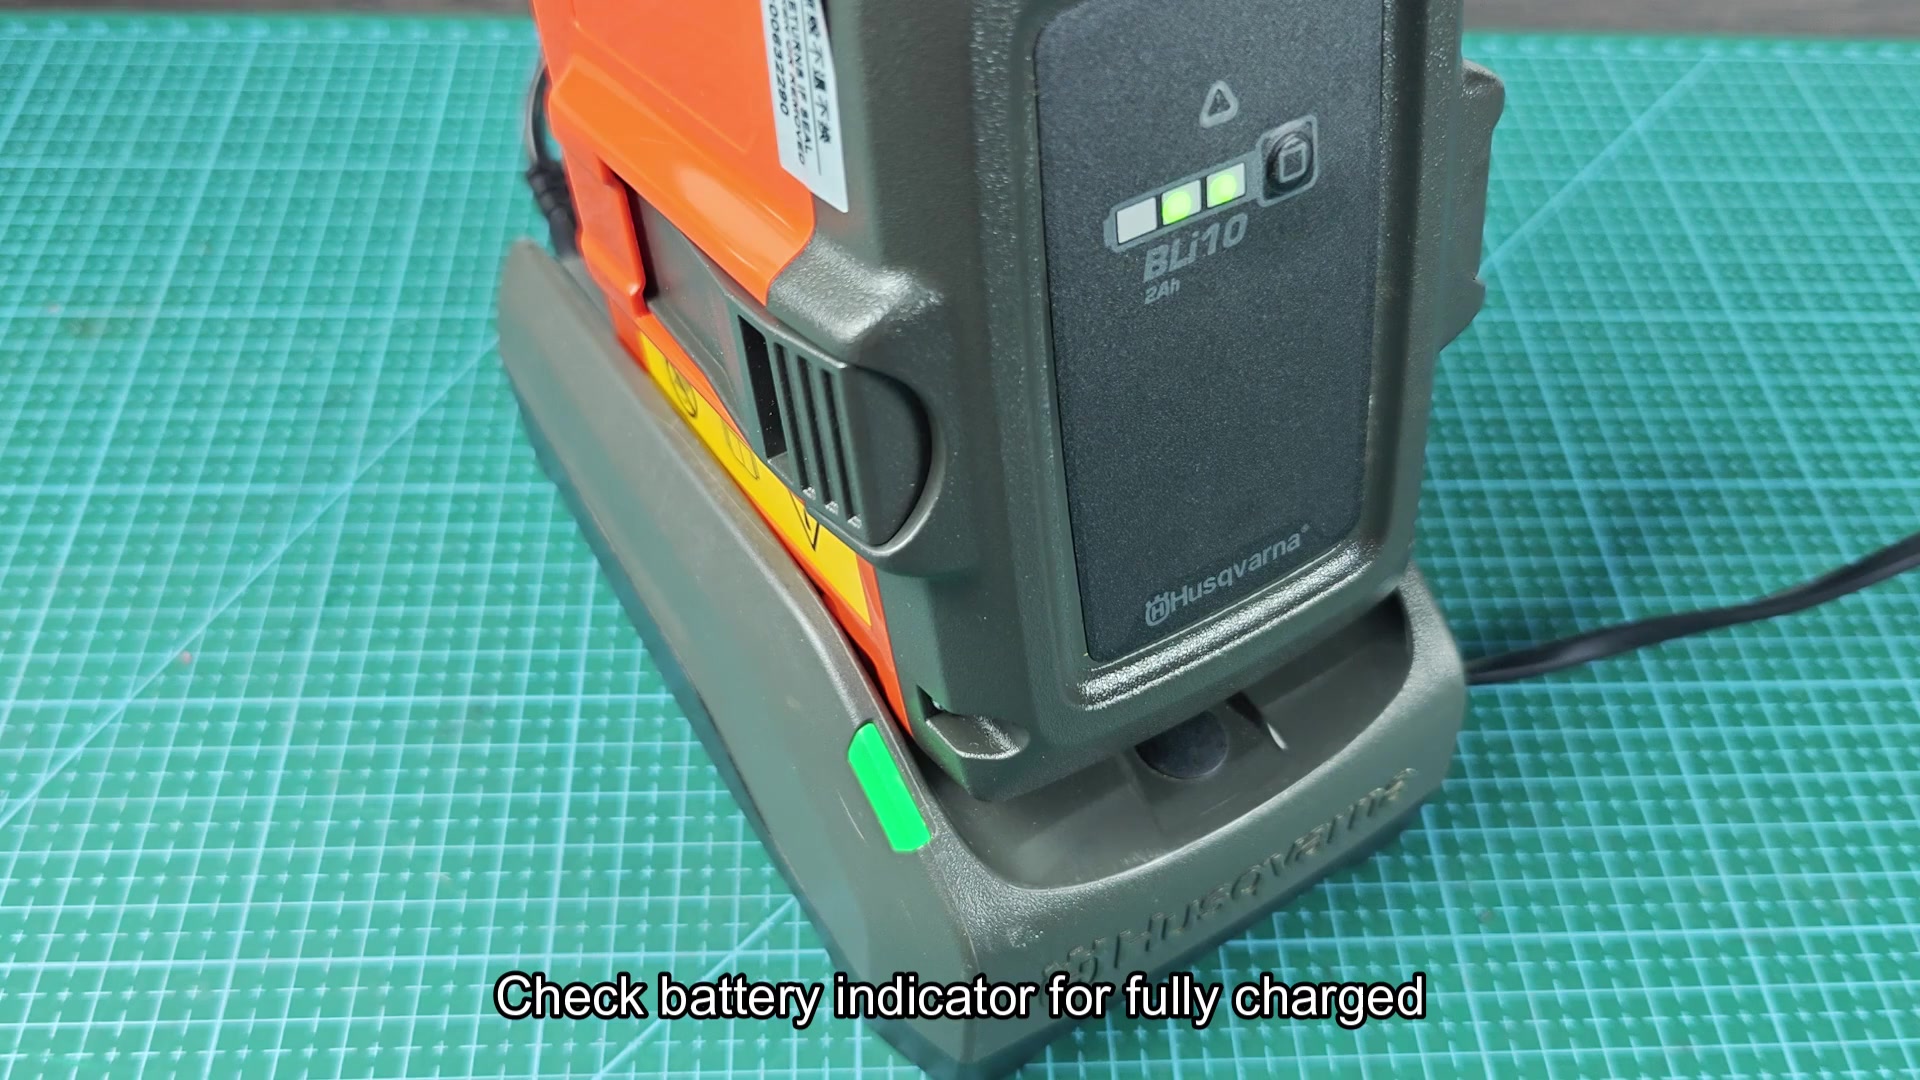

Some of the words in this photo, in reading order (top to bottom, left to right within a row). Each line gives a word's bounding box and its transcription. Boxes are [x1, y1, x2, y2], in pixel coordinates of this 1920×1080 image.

[789, 0, 805, 78] ETURNS
[797, 84, 807, 102] IF
[800, 108, 813, 152] SEAL
[1144, 213, 1248, 282] BLi10
[1144, 278, 1180, 304] 2Ah
[1169, 531, 1303, 613] Husqvarna
